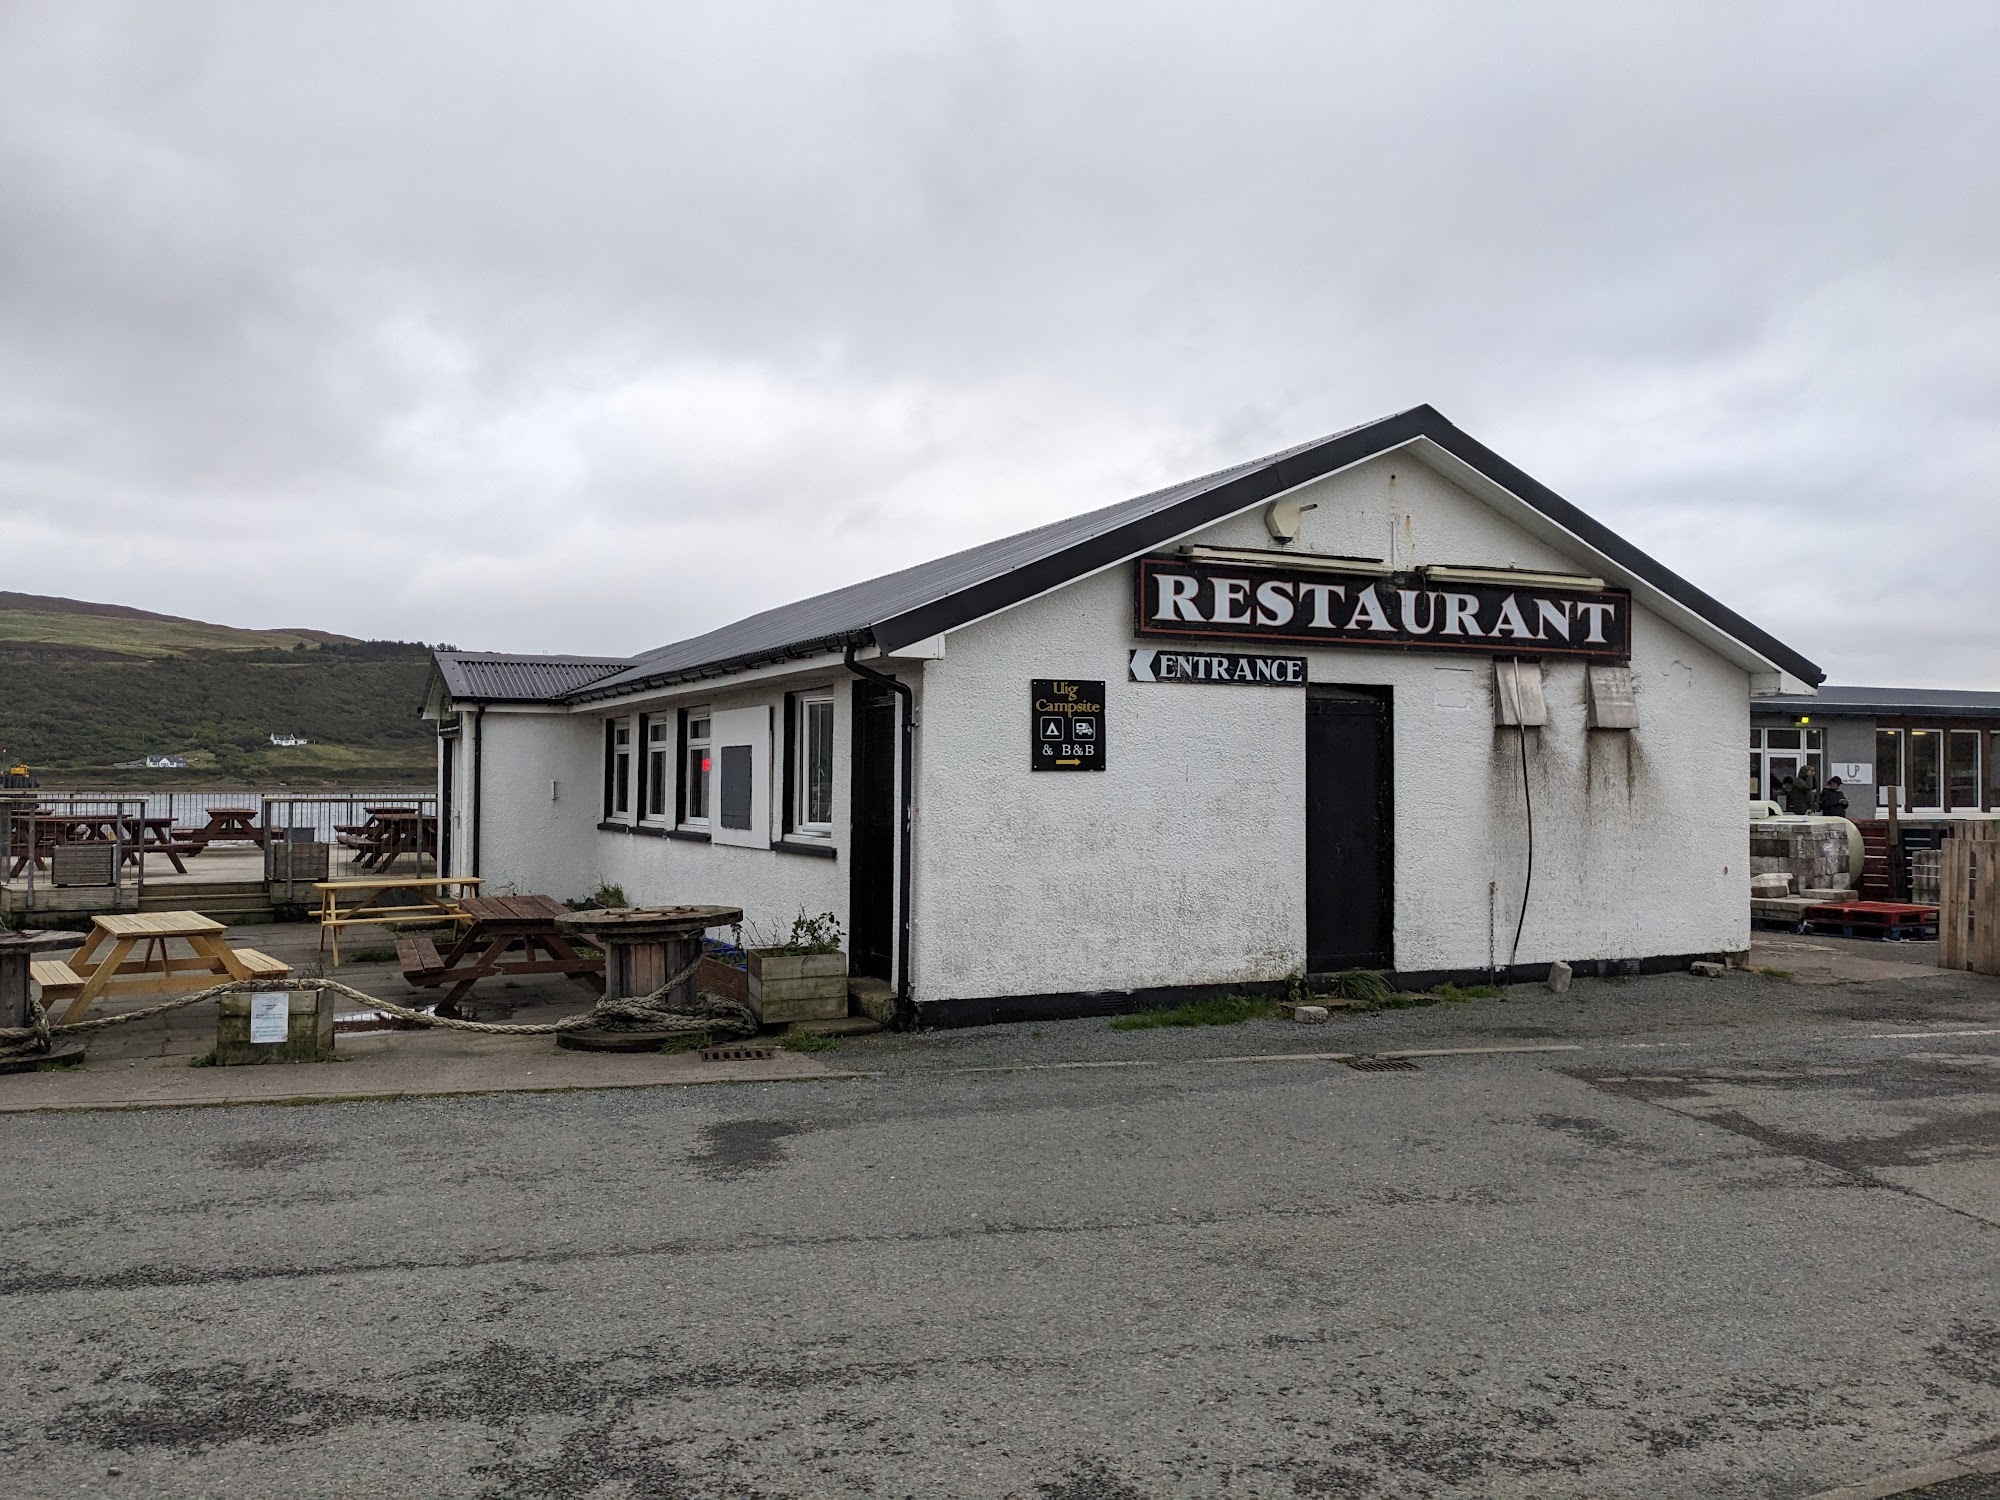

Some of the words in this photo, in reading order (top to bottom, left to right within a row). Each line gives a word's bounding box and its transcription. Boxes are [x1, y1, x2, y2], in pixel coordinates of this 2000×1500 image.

[1151, 572, 1616, 644] RESTAURANT
[1159, 654, 1303, 683] ENTRANCE
[1052, 681, 1079, 702] Uig
[1035, 698, 1101, 719] Campsite
[1042, 743, 1054, 756] &
[1061, 743, 1095, 756] B&B
